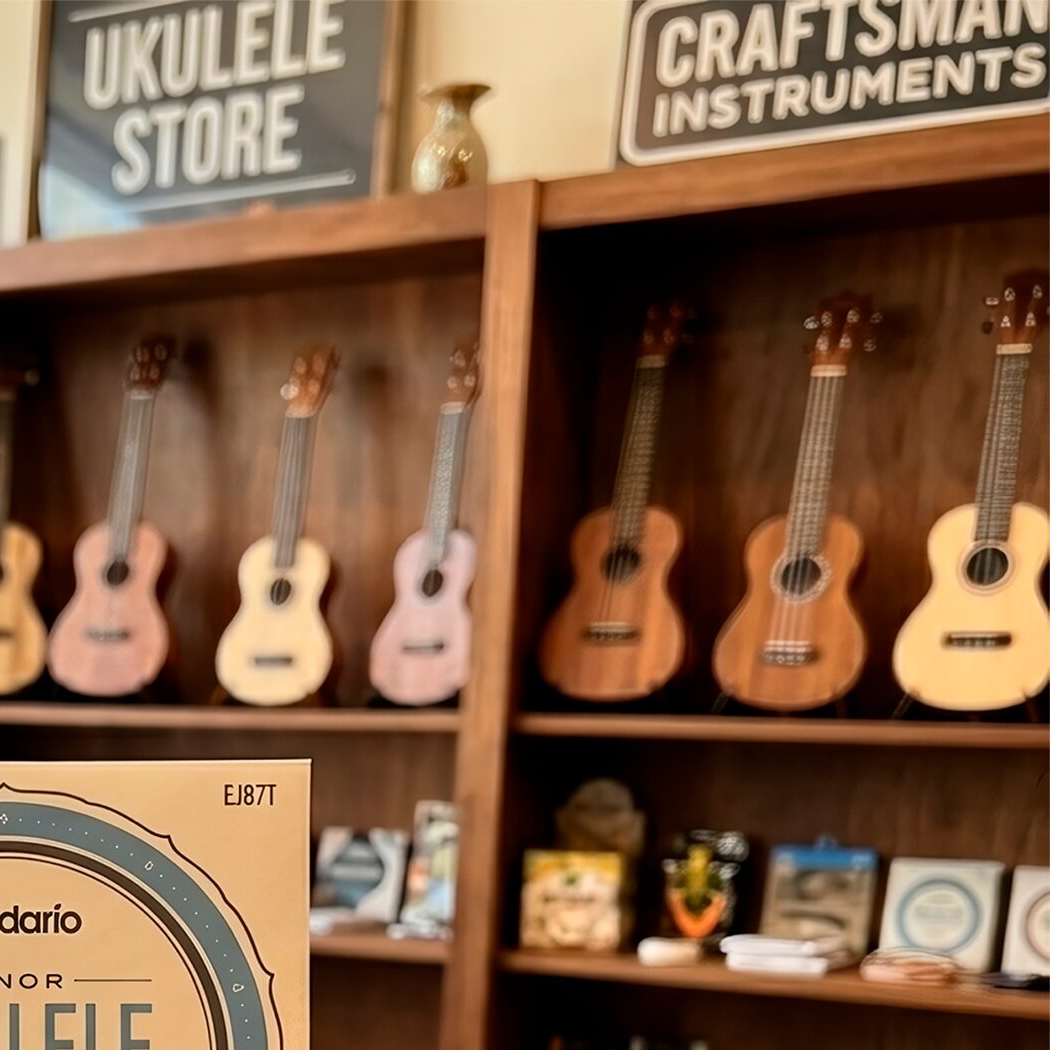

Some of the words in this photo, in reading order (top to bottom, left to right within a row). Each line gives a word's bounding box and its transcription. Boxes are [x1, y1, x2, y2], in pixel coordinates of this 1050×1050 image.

[83, 0, 346, 110] UKULELE
[652, 42, 1047, 138] INSTRUMENTS
[111, 83, 305, 195] STORE
[224, 784, 277, 806] EJ87T
